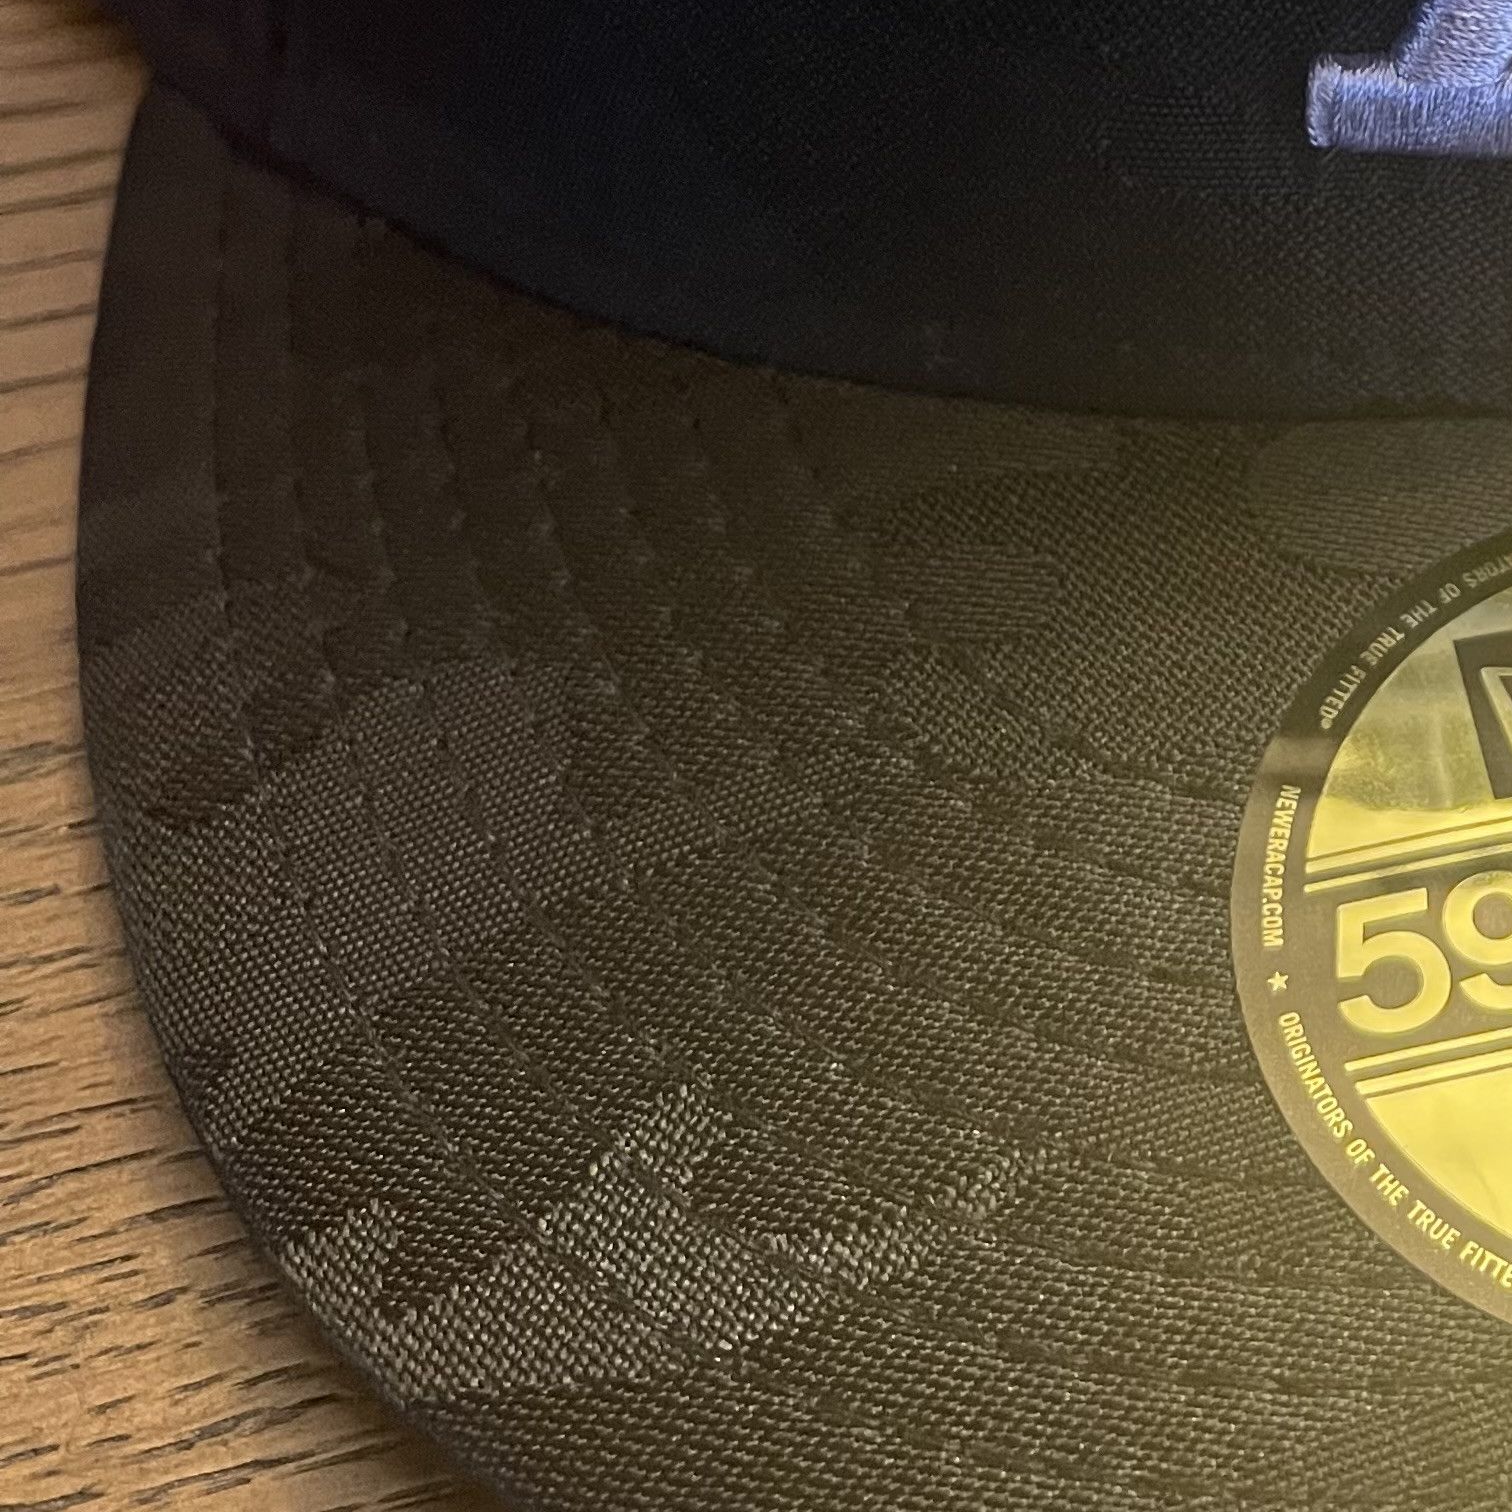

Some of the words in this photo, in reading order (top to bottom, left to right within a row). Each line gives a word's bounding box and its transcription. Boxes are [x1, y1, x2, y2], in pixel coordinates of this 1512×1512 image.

[1400, 599, 1438, 629] THE
[1439, 583, 1462, 604] OF
[1359, 626, 1406, 667] TRUE
[1262, 784, 1302, 947] NEWERACAP.COM
[1278, 1011, 1353, 1138] ORIGINATORS
[1345, 1138, 1376, 1165] OF
[1369, 1163, 1409, 1206] THE
[1407, 1199, 1461, 1250] TRUE
